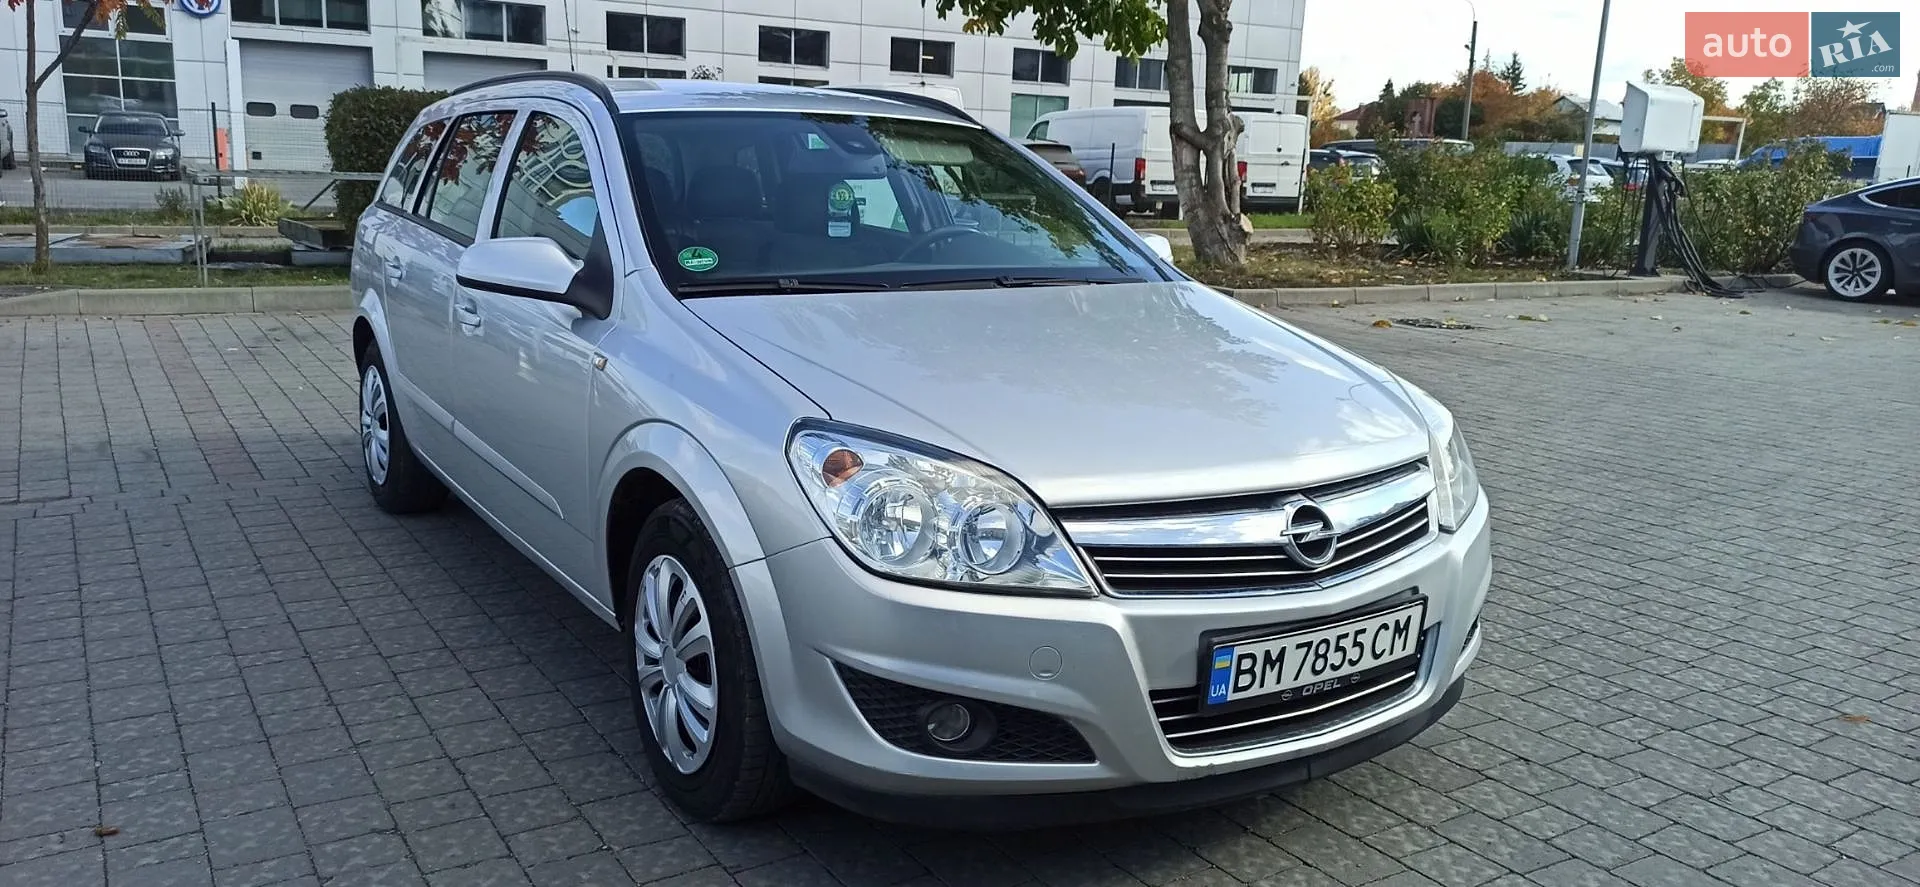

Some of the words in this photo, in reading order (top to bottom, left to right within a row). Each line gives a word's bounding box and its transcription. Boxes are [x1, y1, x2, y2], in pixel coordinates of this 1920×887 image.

[1232, 646, 1287, 694] BM
[1293, 628, 1367, 681] 7855
[1371, 615, 1413, 661] CM
[1211, 684, 1227, 697] UA
[1302, 679, 1342, 696] OPEL
